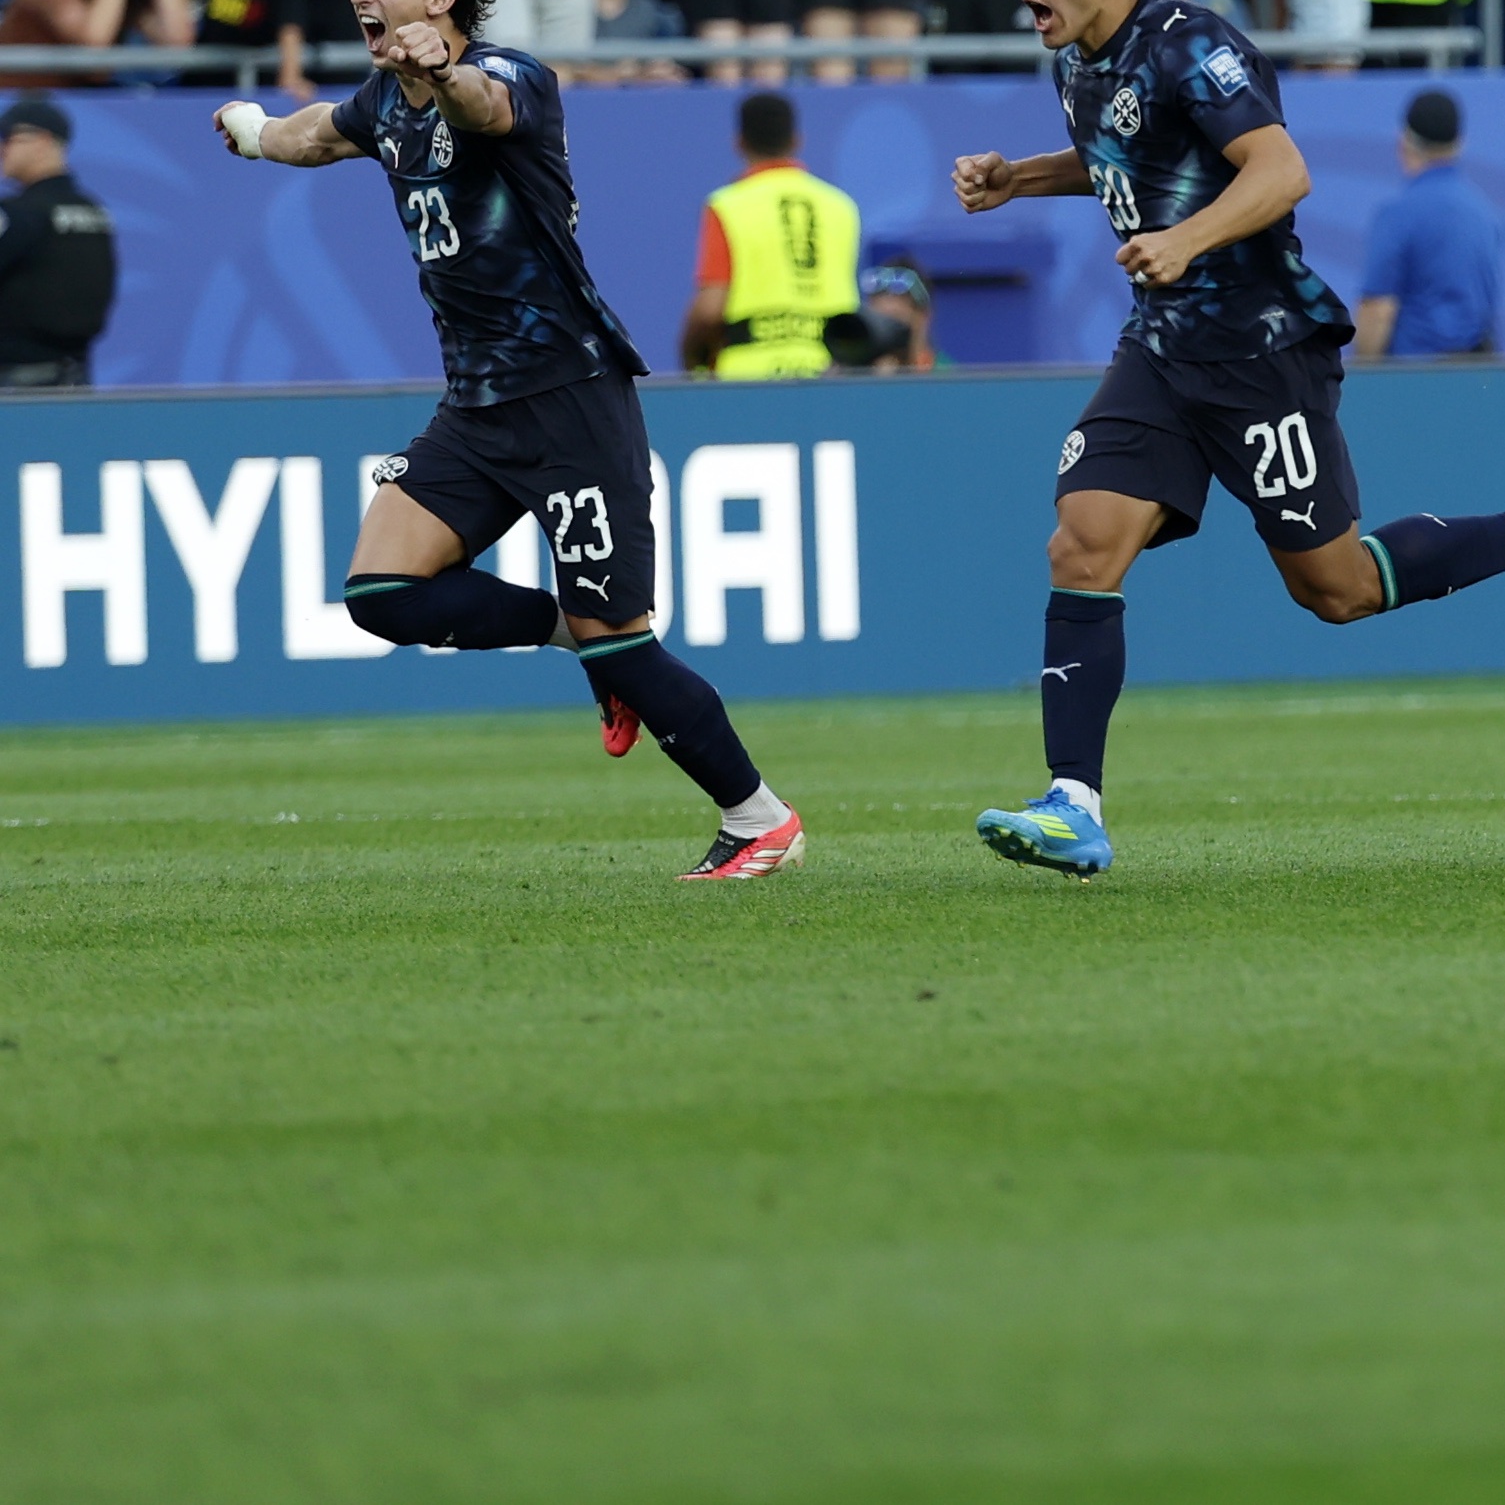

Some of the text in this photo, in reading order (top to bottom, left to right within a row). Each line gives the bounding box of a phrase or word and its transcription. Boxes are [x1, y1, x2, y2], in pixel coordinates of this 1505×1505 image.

[408, 186, 460, 262] 23
[1089, 163, 1141, 231] 20
[1244, 411, 1317, 498] 20
[19, 440, 861, 668] HYUAI
[546, 485, 614, 563] 23
